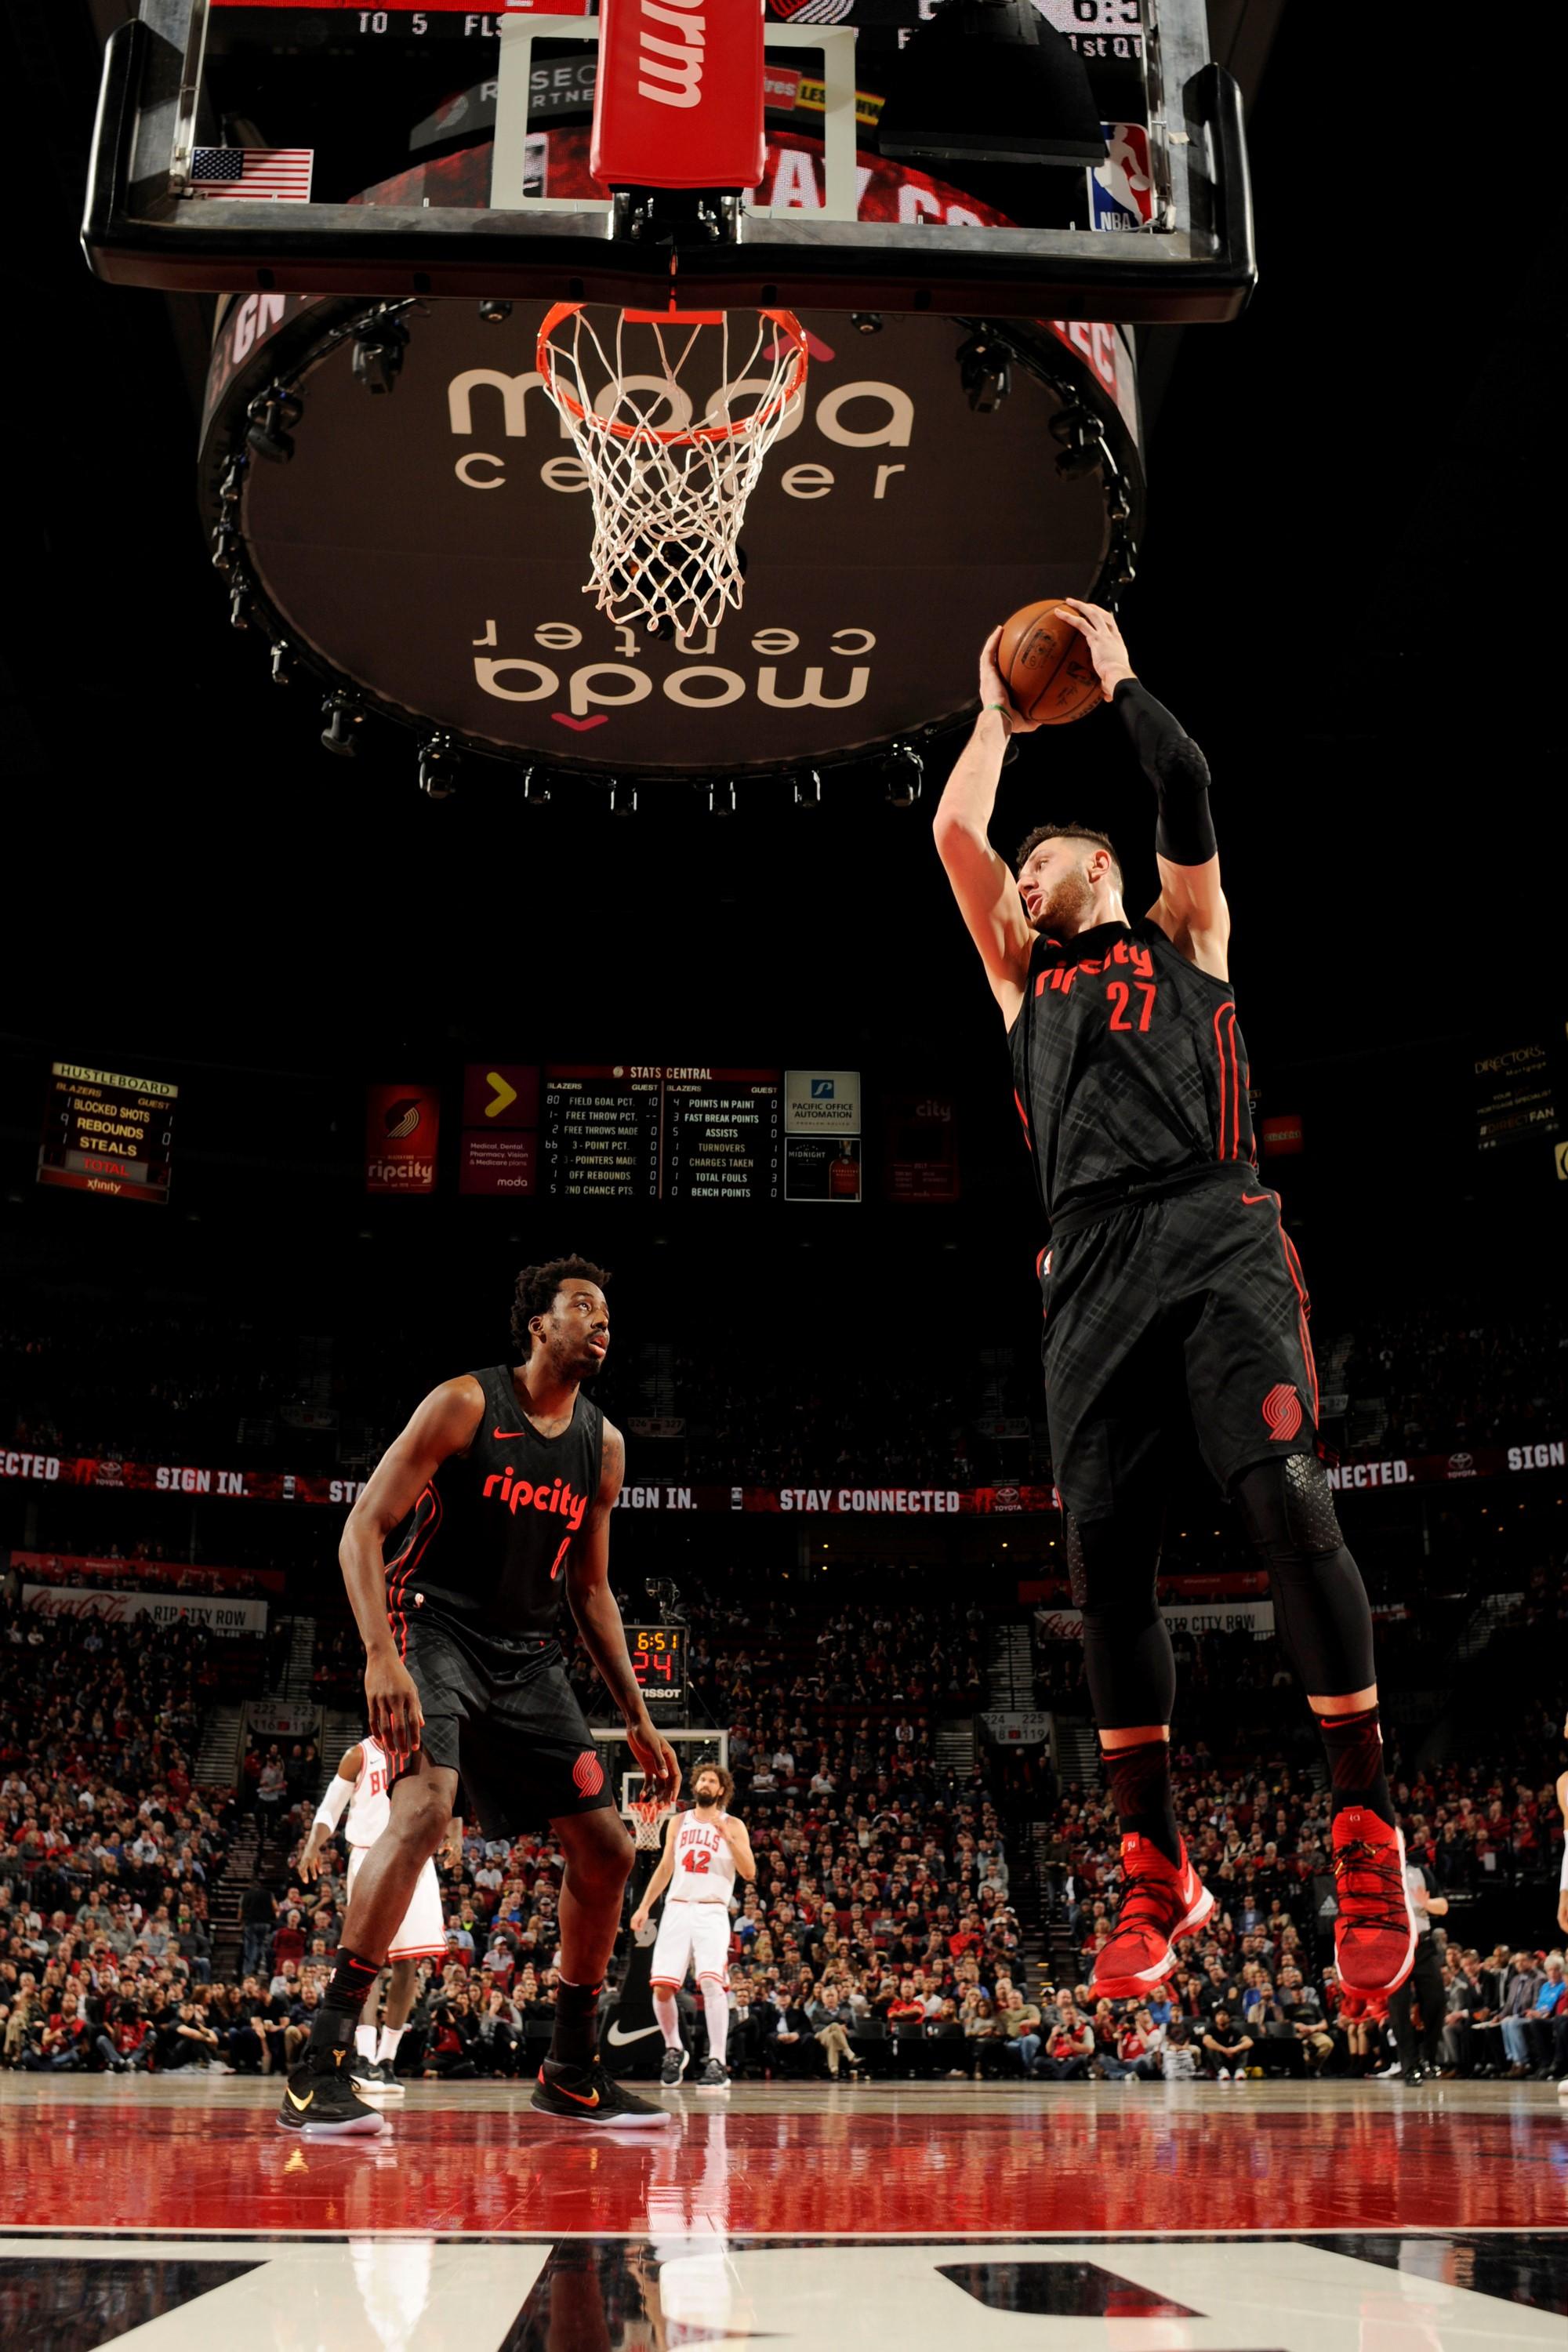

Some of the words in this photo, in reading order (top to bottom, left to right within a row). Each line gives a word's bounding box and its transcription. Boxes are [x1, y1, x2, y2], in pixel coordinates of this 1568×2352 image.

[358, 12, 388, 34] TO
[412, 13, 428, 34] 5
[1069, 34, 1107, 57] 1st
[1113, 36, 1142, 58] QT
[1100, 211, 1133, 230] NBA
[448, 354, 914, 448] moda
[455, 453, 905, 499] center
[473, 619, 877, 657] center
[474, 658, 869, 714] moda
[1106, 981, 1158, 1033] 27
[60, 1064, 171, 1095] HUSTLEBOARD
[630, 1066, 662, 1079] STATS
[666, 1067, 713, 1080] CENTRAL
[56, 1082, 103, 1098] BLAZERS
[546, 1082, 583, 1091] BLAZERS
[665, 1084, 703, 1093] BLAZERS
[750, 1086, 778, 1094] GUEST
[137, 1098, 171, 1110] GUEST
[568, 1097, 593, 1106] FIELD
[594, 1098, 615, 1106] GOAL
[689, 1098, 719, 1109] POINTS
[720, 1099, 729, 1109] IN
[731, 1100, 756, 1109] PAINT
[792, 1102, 823, 1111] PACIFIC
[74, 1098, 118, 1116] BLOCKED
[119, 1106, 151, 1123] SHOTS
[565, 1110, 586, 1120] FREE
[589, 1111, 618, 1121] THROW
[684, 1113, 703, 1123] FAST
[705, 1113, 730, 1123] BREAK
[731, 1114, 760, 1123] POINTS
[77, 1117, 144, 1140] REBOUNDS
[564, 1125, 583, 1135] FREE
[585, 1126, 616, 1135] THROWS
[617, 1126, 639, 1136] MADE
[706, 1128, 739, 1138] ASSISTS
[79, 1136, 137, 1156] STEALS
[585, 1141, 610, 1151] POINT
[698, 1142, 746, 1153] TURNOVERS
[84, 1156, 130, 1177] TOTAL
[575, 1155, 614, 1165] POINTERS
[615, 1156, 638, 1165] MADE
[689, 1157, 727, 1167] CHARGES
[728, 1158, 754, 1167] TAKEN
[368, 1160, 434, 1184] ripcity
[568, 1170, 585, 1180] OFF
[586, 1170, 631, 1181] REBOUNDS
[696, 1172, 720, 1182] TOTAL
[721, 1173, 748, 1183] FOULS
[87, 1178, 122, 1194] xfinity
[497, 1175, 528, 1187] moda
[564, 1185, 581, 1195] 2ND
[583, 1185, 615, 1196] CHANCE
[691, 1187, 720, 1197] BENCH
[721, 1187, 751, 1198] POINTS
[1507, 1441, 1566, 1472] SIGN
[155, 1466, 211, 1494] SIGN
[216, 1472, 250, 1496] IN.
[1446, 1469, 1479, 1479] TOYOTA
[95, 1479, 125, 1487] TOYOTA
[482, 1465, 589, 1530] ripcity
[666, 1487, 698, 1509] IN.
[779, 1487, 830, 1512] STAY
[837, 1488, 960, 1512] CONNECTED
[154, 1605, 178, 1622] RIP
[216, 1610, 246, 1626] ROW
[1192, 1615, 1222, 1632] CITY
[637, 1631, 678, 1651] 6:51
[631, 1650, 673, 1683] 24
[253, 1704, 277, 1715] 222
[294, 1705, 316, 1716] 223
[984, 1714, 1005, 1725] 224
[1022, 1713, 1045, 1724] 225
[1022, 1729, 1045, 1740] 119
[680, 1828, 721, 1853] BULLS
[681, 1849, 712, 1875] 42
